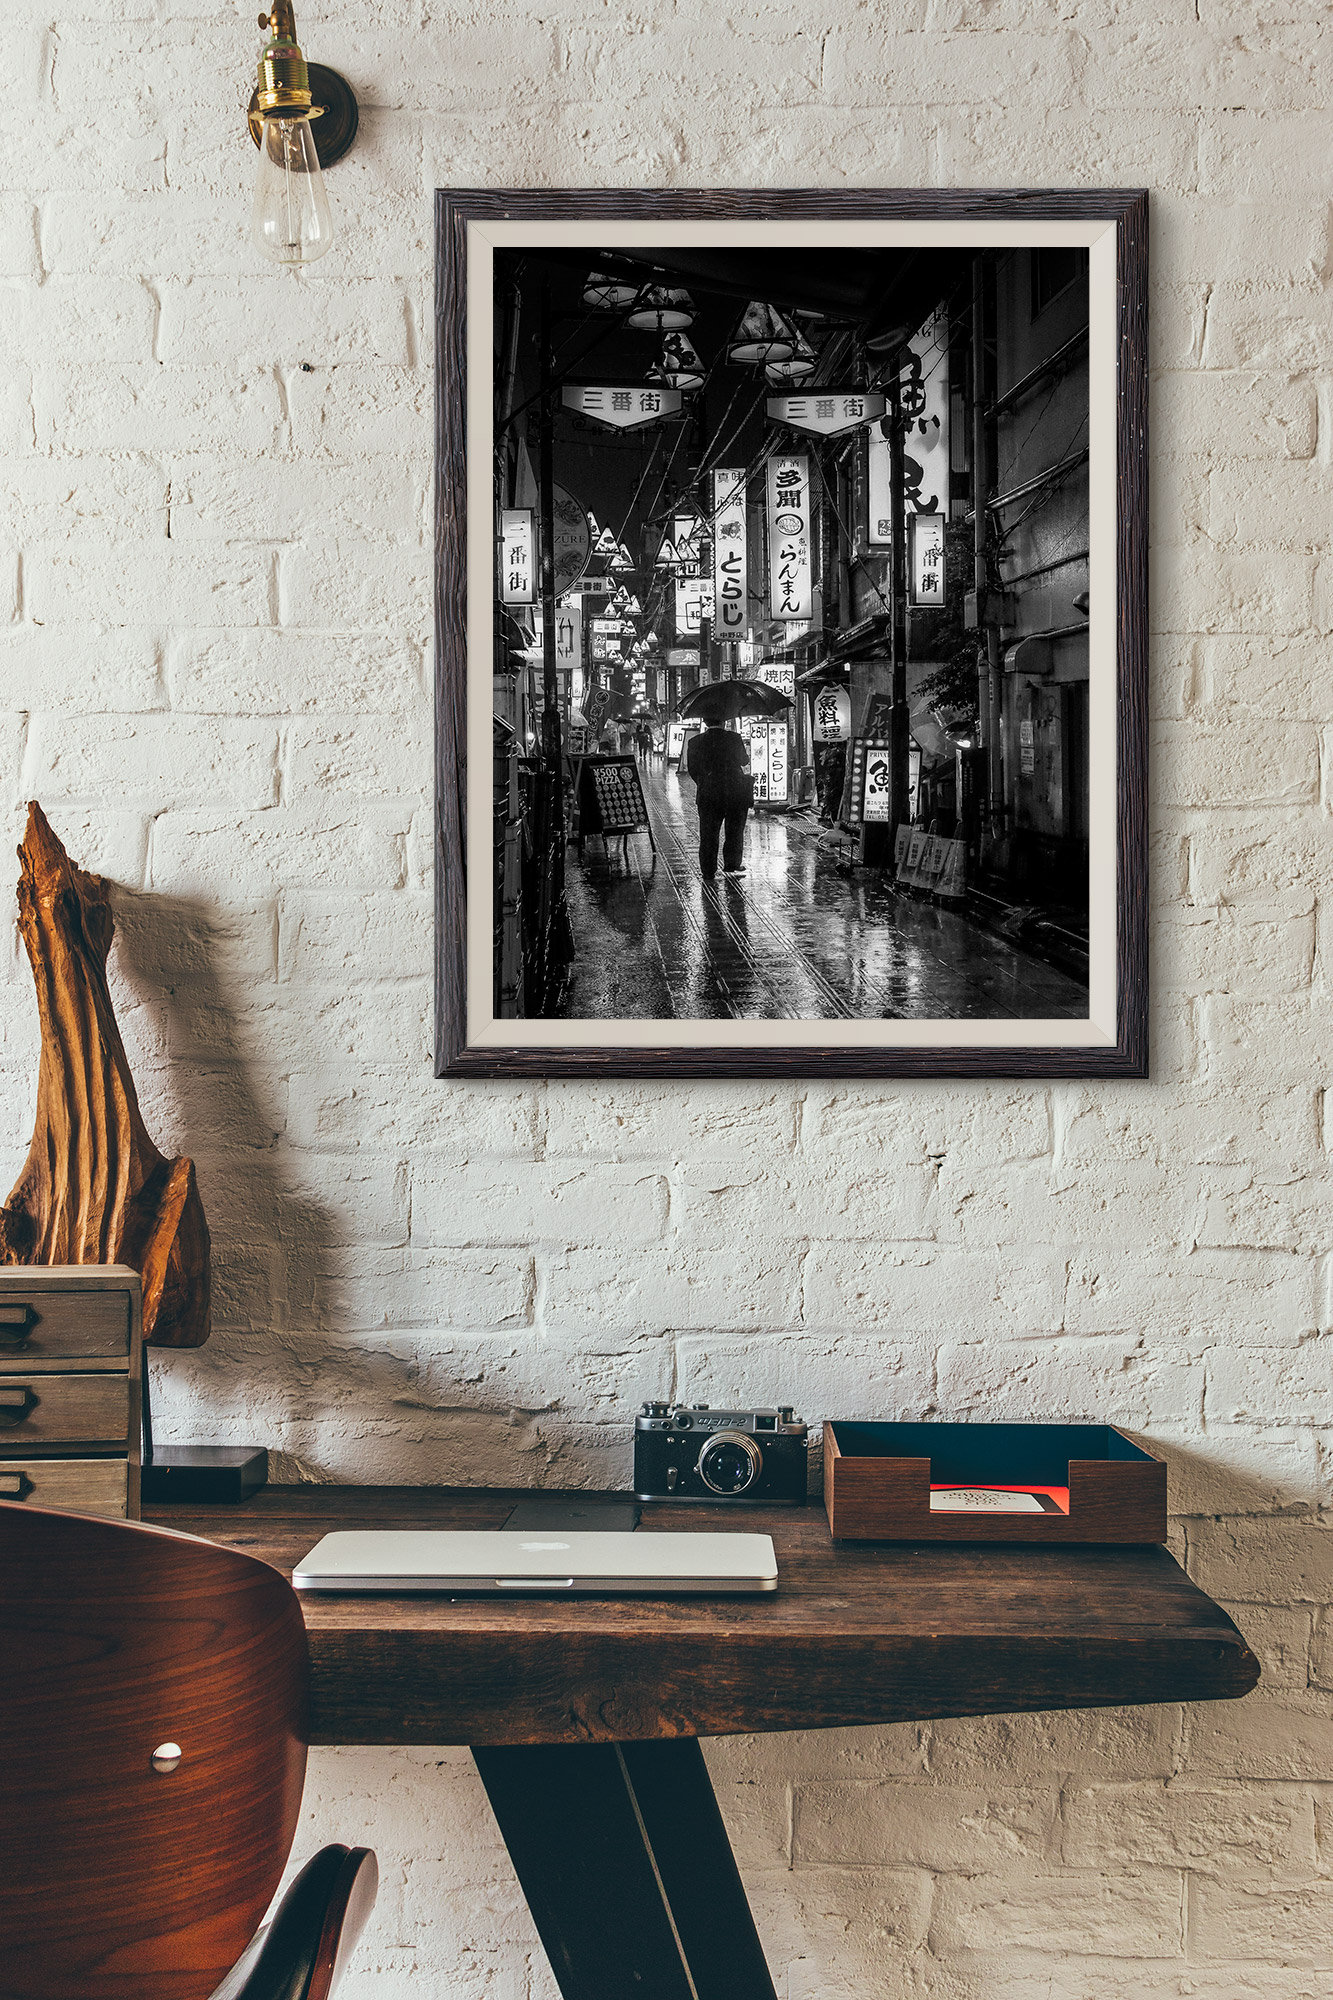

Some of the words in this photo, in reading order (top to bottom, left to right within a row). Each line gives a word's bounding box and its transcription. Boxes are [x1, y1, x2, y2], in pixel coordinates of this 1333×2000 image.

[583, 391, 661, 412] 三番街
[787, 398, 864, 418] 三番街
[508, 520, 528, 592] 三番街
[921, 525, 940, 592] 三番街
[720, 551, 743, 626] とらじ
[778, 544, 800, 613] らんまん
[764, 669, 793, 683] 焼肉
[818, 694, 842, 739] 魚料理
[593, 767, 618, 777] ¥500
[595, 775, 620, 784] PIZZA
[772, 748, 784, 782] とらじ
